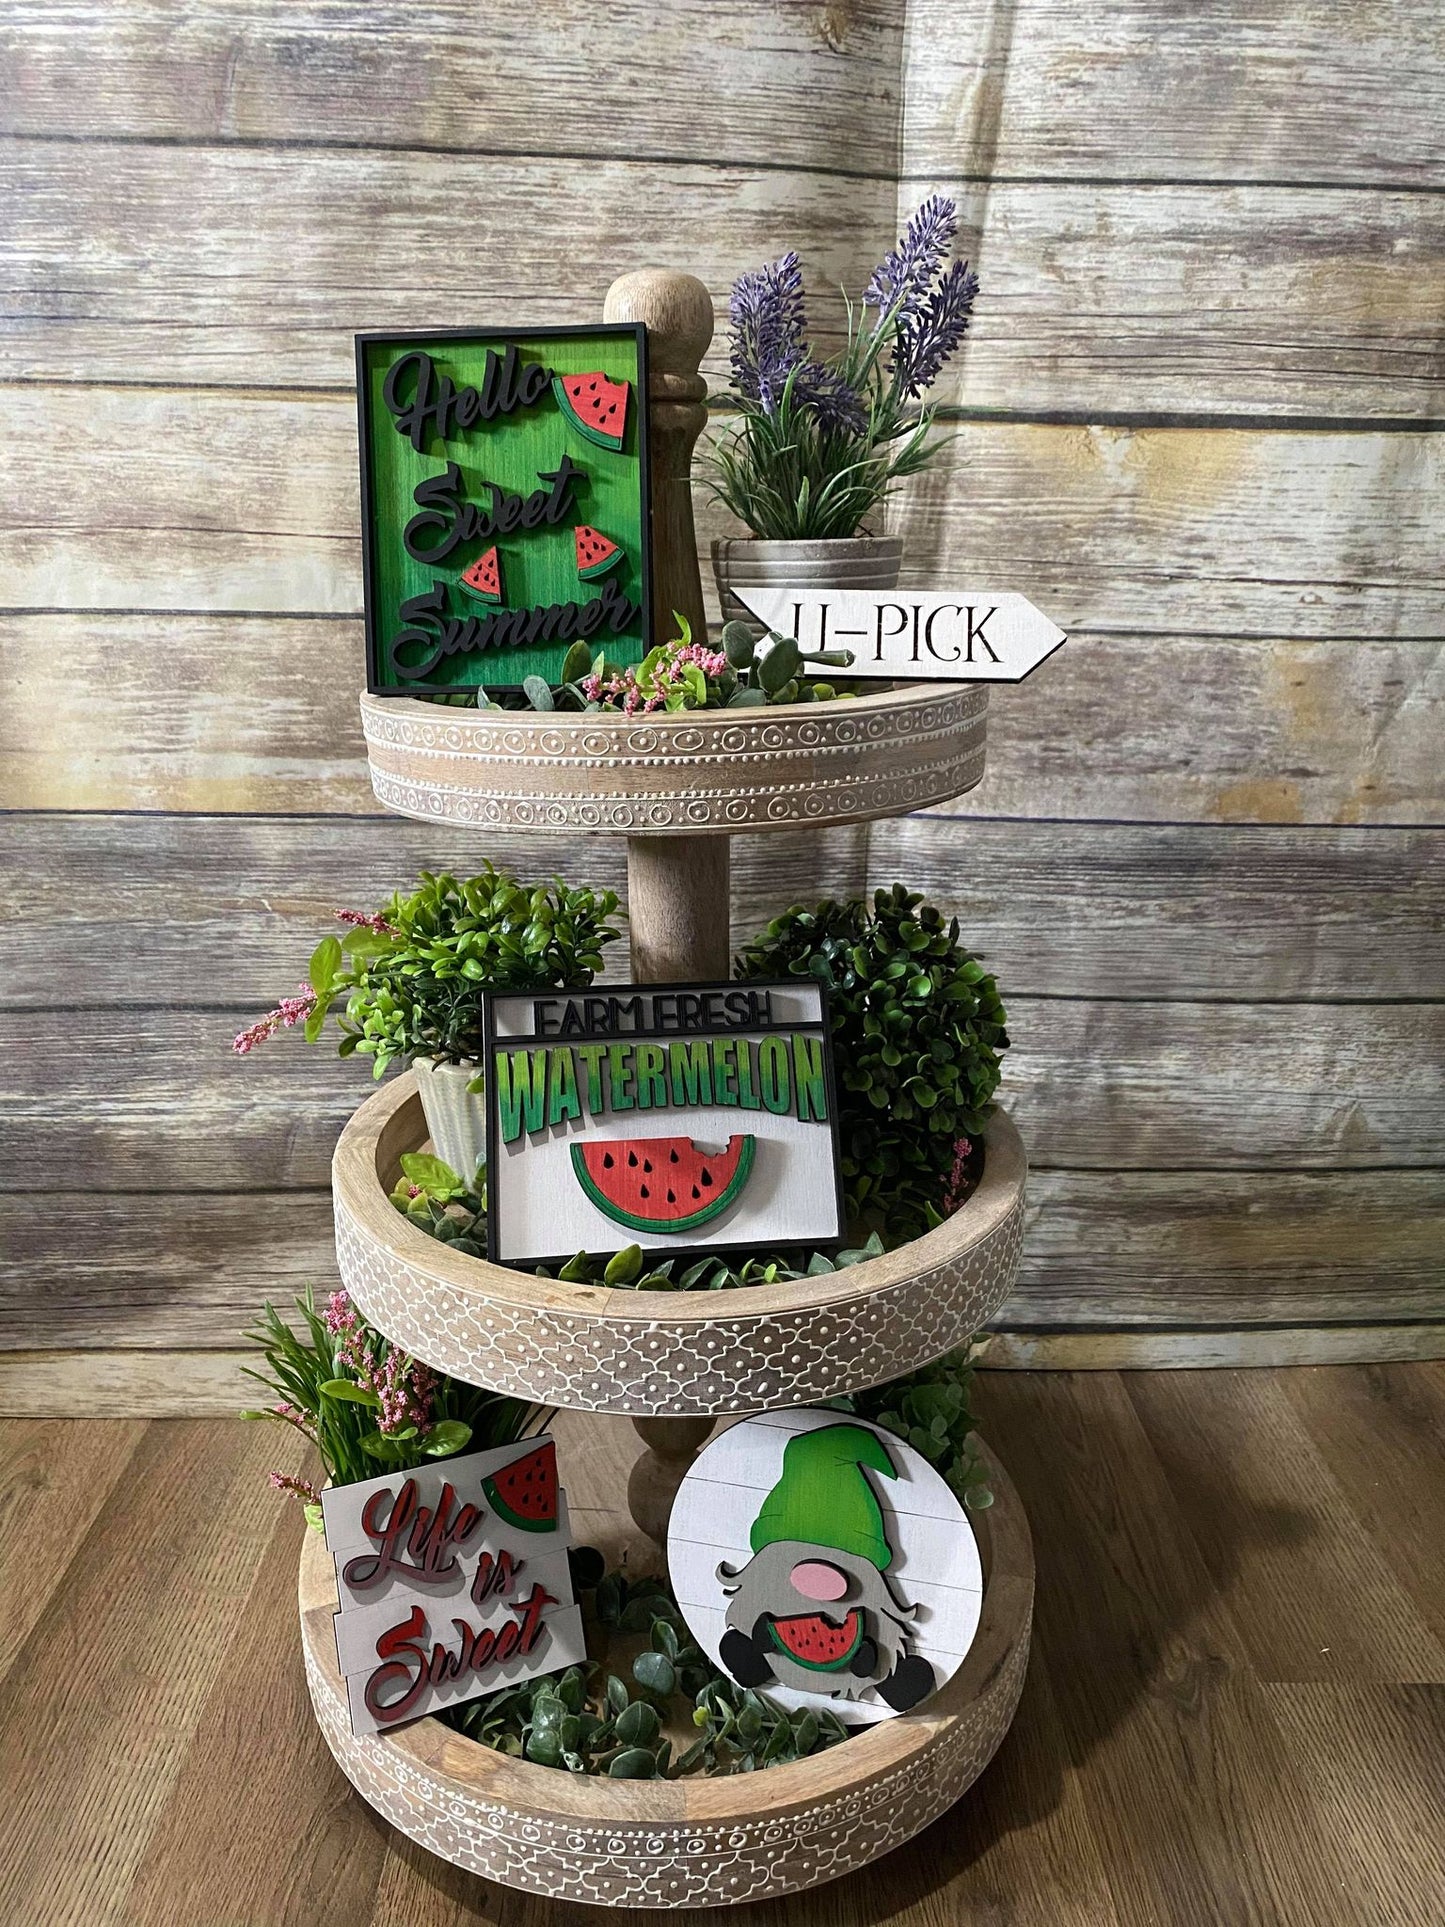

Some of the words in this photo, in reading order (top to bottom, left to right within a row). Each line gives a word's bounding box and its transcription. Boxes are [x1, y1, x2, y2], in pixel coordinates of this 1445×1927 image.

[383, 344, 554, 453] Hello
[404, 454, 588, 563] Sweet
[388, 578, 640, 679] Summer
[793, 603, 1004, 663] U-PICK
[534, 994, 644, 1036] FARM
[652, 990, 773, 1030] FRESH
[495, 1033, 827, 1144] WATERMELON
[343, 1478, 484, 1591] Life
[470, 1549, 526, 1605] is
[364, 1582, 559, 1722] Sweet
